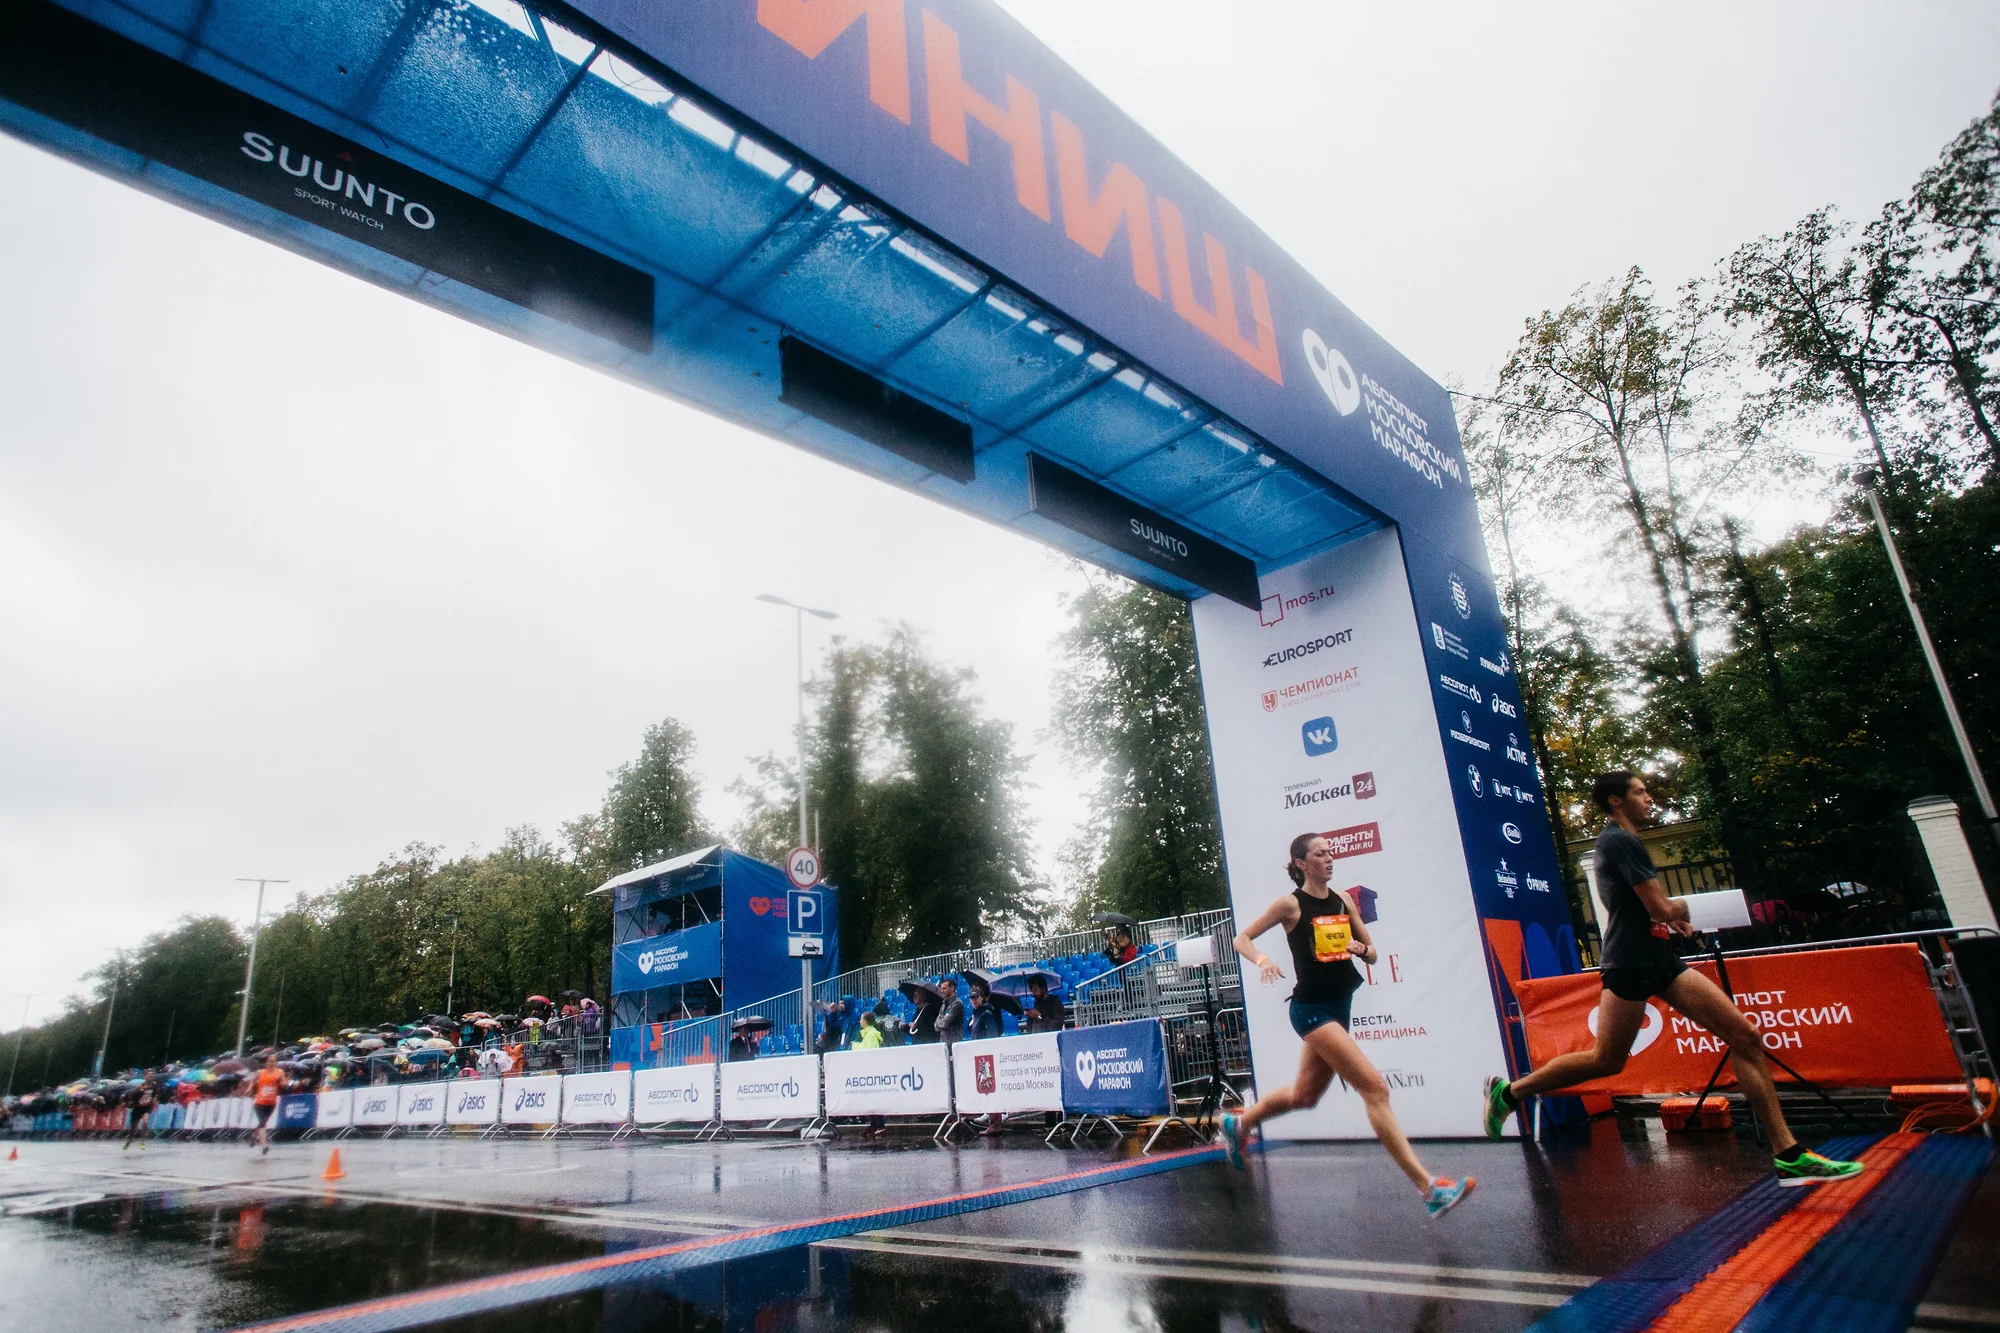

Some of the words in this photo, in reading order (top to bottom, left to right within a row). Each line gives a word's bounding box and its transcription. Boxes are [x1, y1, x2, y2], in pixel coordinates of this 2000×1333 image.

[240, 131, 435, 230] SUUNTO
[294, 187, 336, 212] SPORT
[340, 205, 384, 231] WATCH
[1362, 372, 1428, 435] АБСОЛЮТ
[1364, 392, 1462, 483] МОСКОВСКИЙ
[1370, 420, 1442, 489] МАРАФОН
[1130, 518, 1188, 557] SUUNTO
[1285, 585, 1335, 610] mos.ru
[1263, 628, 1353, 668] EUROSPORT
[1280, 666, 1359, 698] ЧЕМПИОНАТ
[1284, 778, 1322, 792] телеканал
[1284, 783, 1351, 809] Москва
[1356, 779, 1374, 793] 24
[1326, 829, 1374, 847] УМЕНТЫ
[1330, 843, 1348, 855] КТЫ
[1350, 840, 1373, 852] AIF.RU
[795, 859, 814, 875] 40
[798, 896, 816, 928] P
[654, 951, 688, 965] МОСКОВСКИЙ
[654, 963, 679, 973] МАРАФОН
[1352, 1015, 1397, 1027] ВЕСТИ.
[1671, 1002, 1852, 1034] МОВСКИЙ
[1354, 1026, 1427, 1041] МЕДИЦИНА
[1676, 1031, 1803, 1054] МАРОН
[999, 1052, 1043, 1064] Департамент
[1096, 1048, 1128, 1060] АБСОЛЮТ
[1000, 1067, 1023, 1078] спорта
[1031, 1065, 1060, 1076] туризма
[1097, 1058, 1144, 1075] МОСКОВСКИЙ
[737, 1082, 779, 1094] АБСОЛЮТ
[845, 1075, 897, 1088] АБСОЛЮТ
[1001, 1081, 1025, 1092] города
[1026, 1079, 1055, 1090] Москвы
[1098, 1077, 1132, 1090] МАРАФОН
[524, 1092, 546, 1107] asics
[574, 1093, 603, 1102] АБСОЛЮТ
[648, 1089, 682, 1099] АБСОЛЮТ
[370, 1100, 387, 1112] asics
[416, 1098, 433, 1111] asics
[466, 1095, 486, 1110] asics
